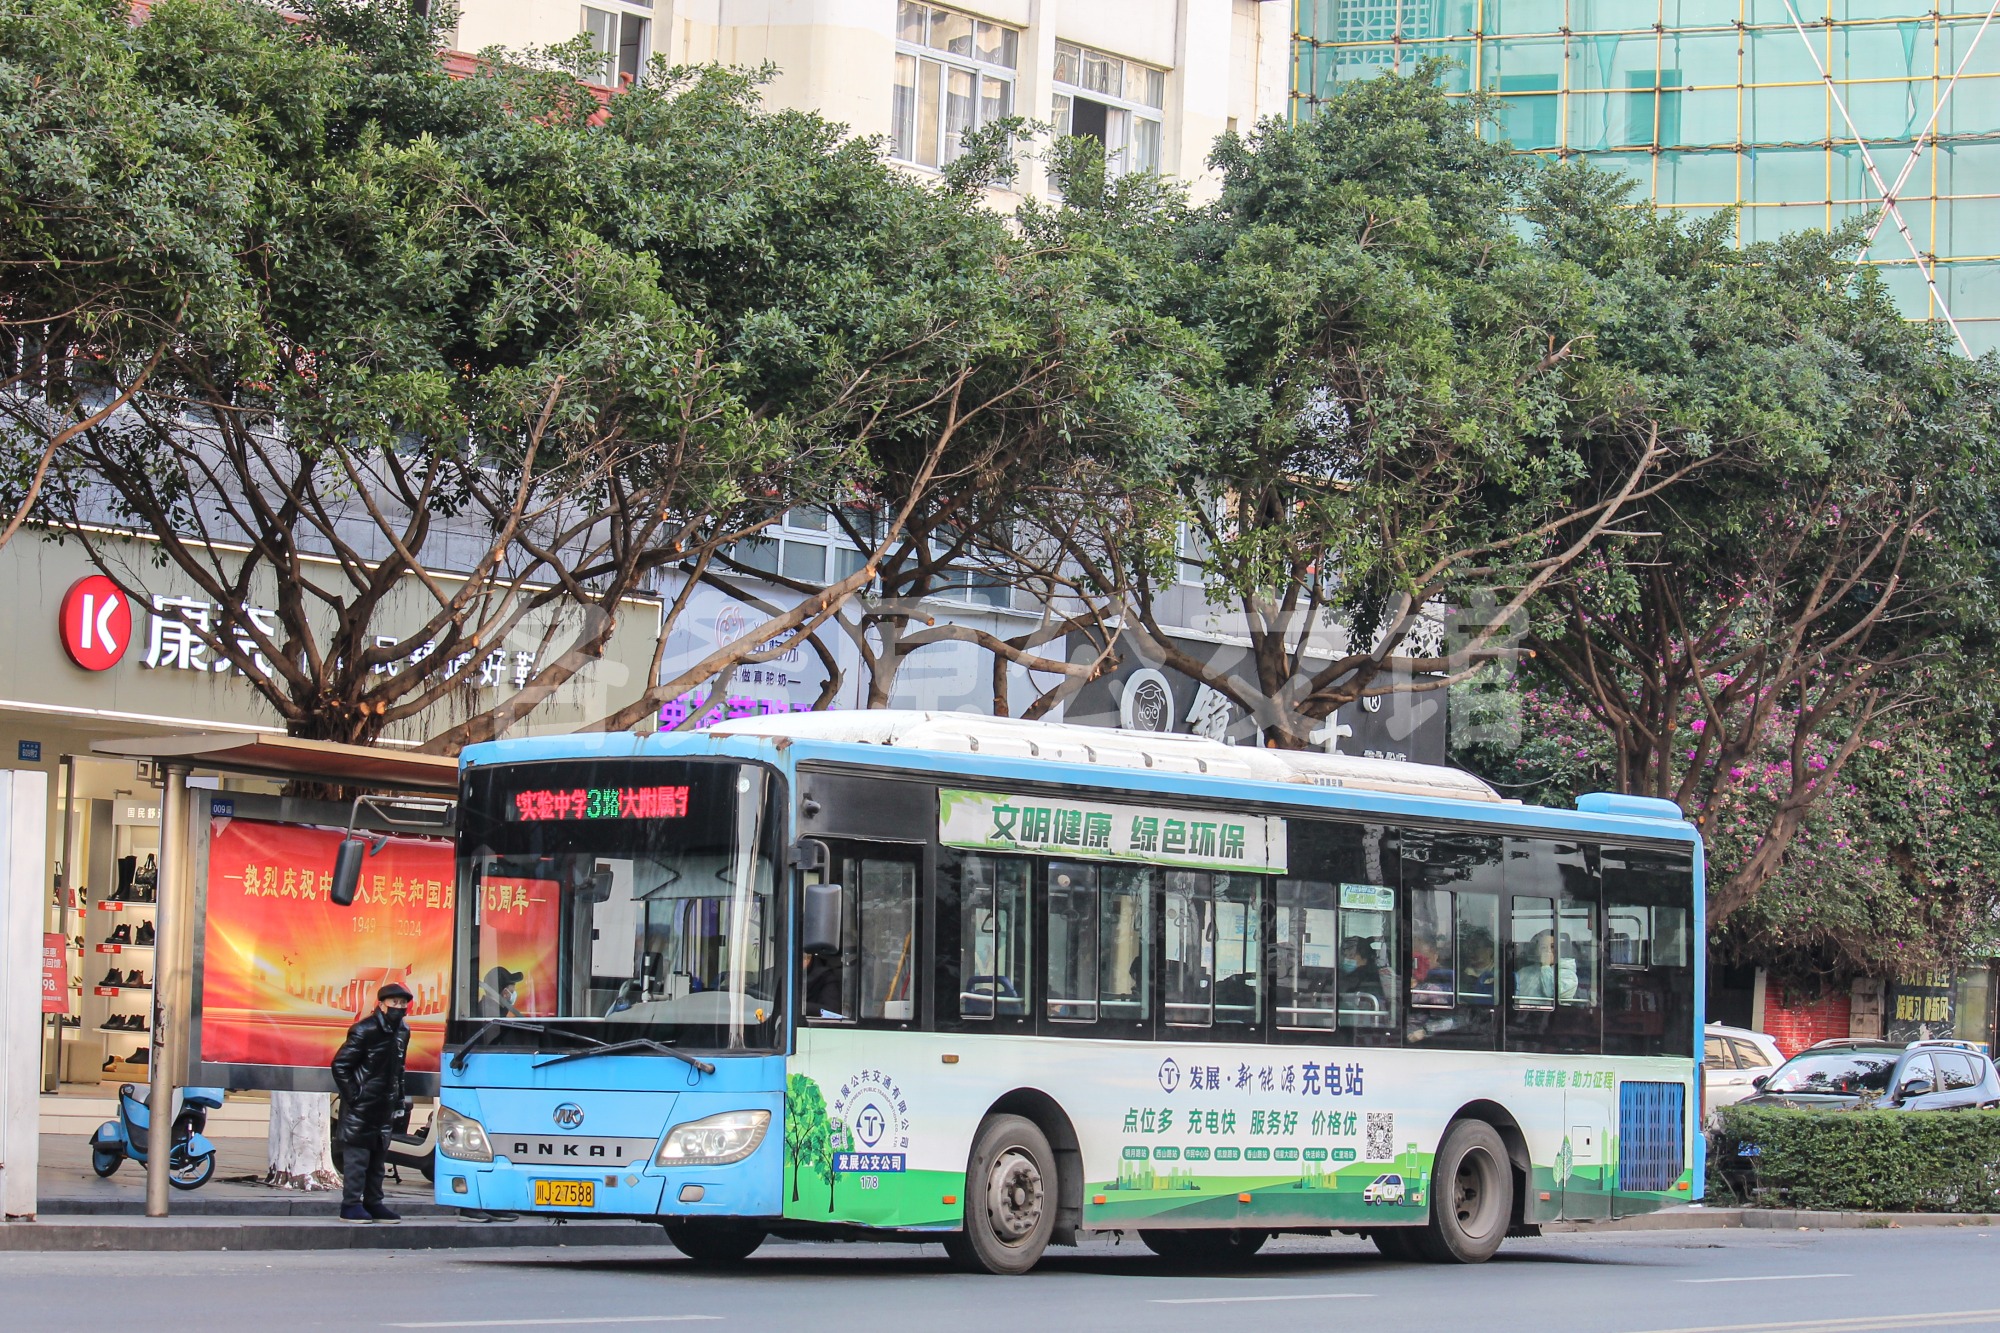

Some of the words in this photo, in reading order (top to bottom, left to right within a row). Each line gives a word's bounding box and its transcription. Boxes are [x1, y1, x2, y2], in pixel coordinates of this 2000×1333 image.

[127, 807, 161, 819] 国民舒
[989, 804, 1113, 849] 文明健康
[1129, 815, 1245, 860] 绿色环保
[1122, 1107, 1173, 1134] 点位多
[1187, 1108, 1237, 1136] 充电快
[1250, 1109, 1299, 1136] 服务好
[1311, 1110, 1358, 1137] 价格优
[513, 1142, 622, 1158] ANKAI
[838, 1154, 902, 1171] 发展公交公司
[860, 1175, 879, 1189] 178
